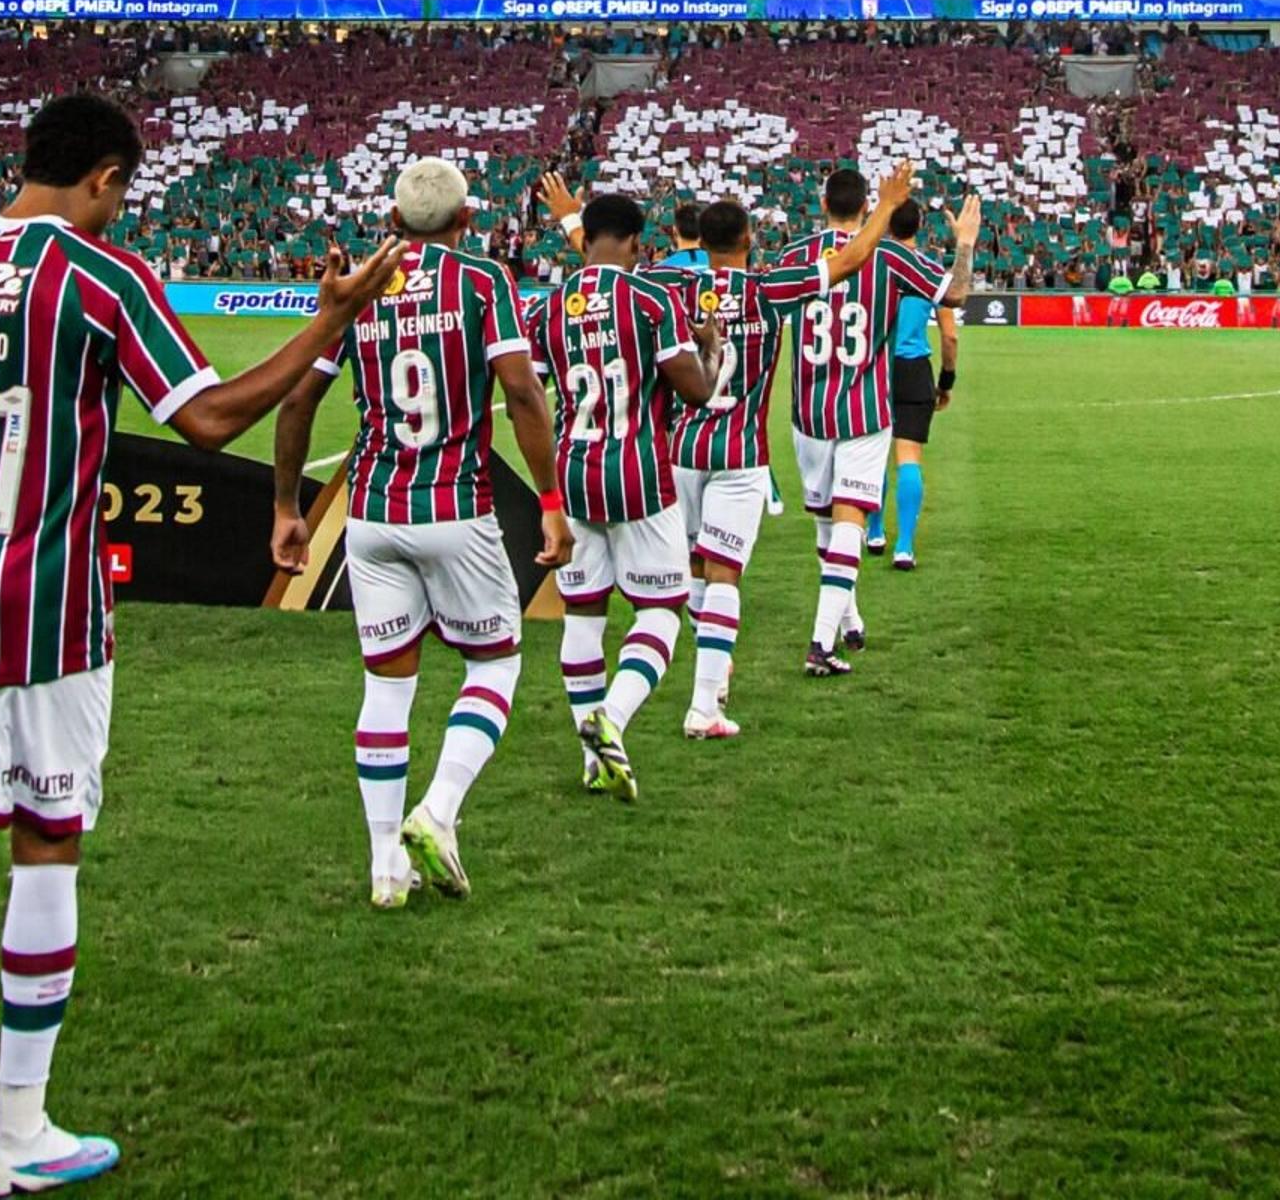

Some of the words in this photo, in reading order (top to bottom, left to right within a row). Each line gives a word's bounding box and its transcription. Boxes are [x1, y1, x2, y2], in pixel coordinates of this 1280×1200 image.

[9, 2, 17, 12] o
[125, 1, 144, 13] no
[147, 0, 218, 16] Instagram
[503, 0, 534, 16] Siga
[538, 4, 548, 14] o
[661, 3, 679, 14] no
[981, 0, 1014, 16] Siga
[1017, 3, 1027, 14] o
[1144, 3, 1163, 15] no
[1167, 0, 1243, 17] Instagram
[217, 291, 321, 314] sporting
[381, 291, 434, 306] DELIVERY
[397, 311, 464, 337] KENNEDY
[568, 312, 610, 325] DELIVERY
[1140, 300, 1221, 328] Coca-Cola
[727, 320, 769, 335] XAVIER
[803, 301, 869, 367] 33
[580, 329, 616, 350] ARIAS
[390, 349, 440, 448] 9
[566, 358, 630, 442] 21
